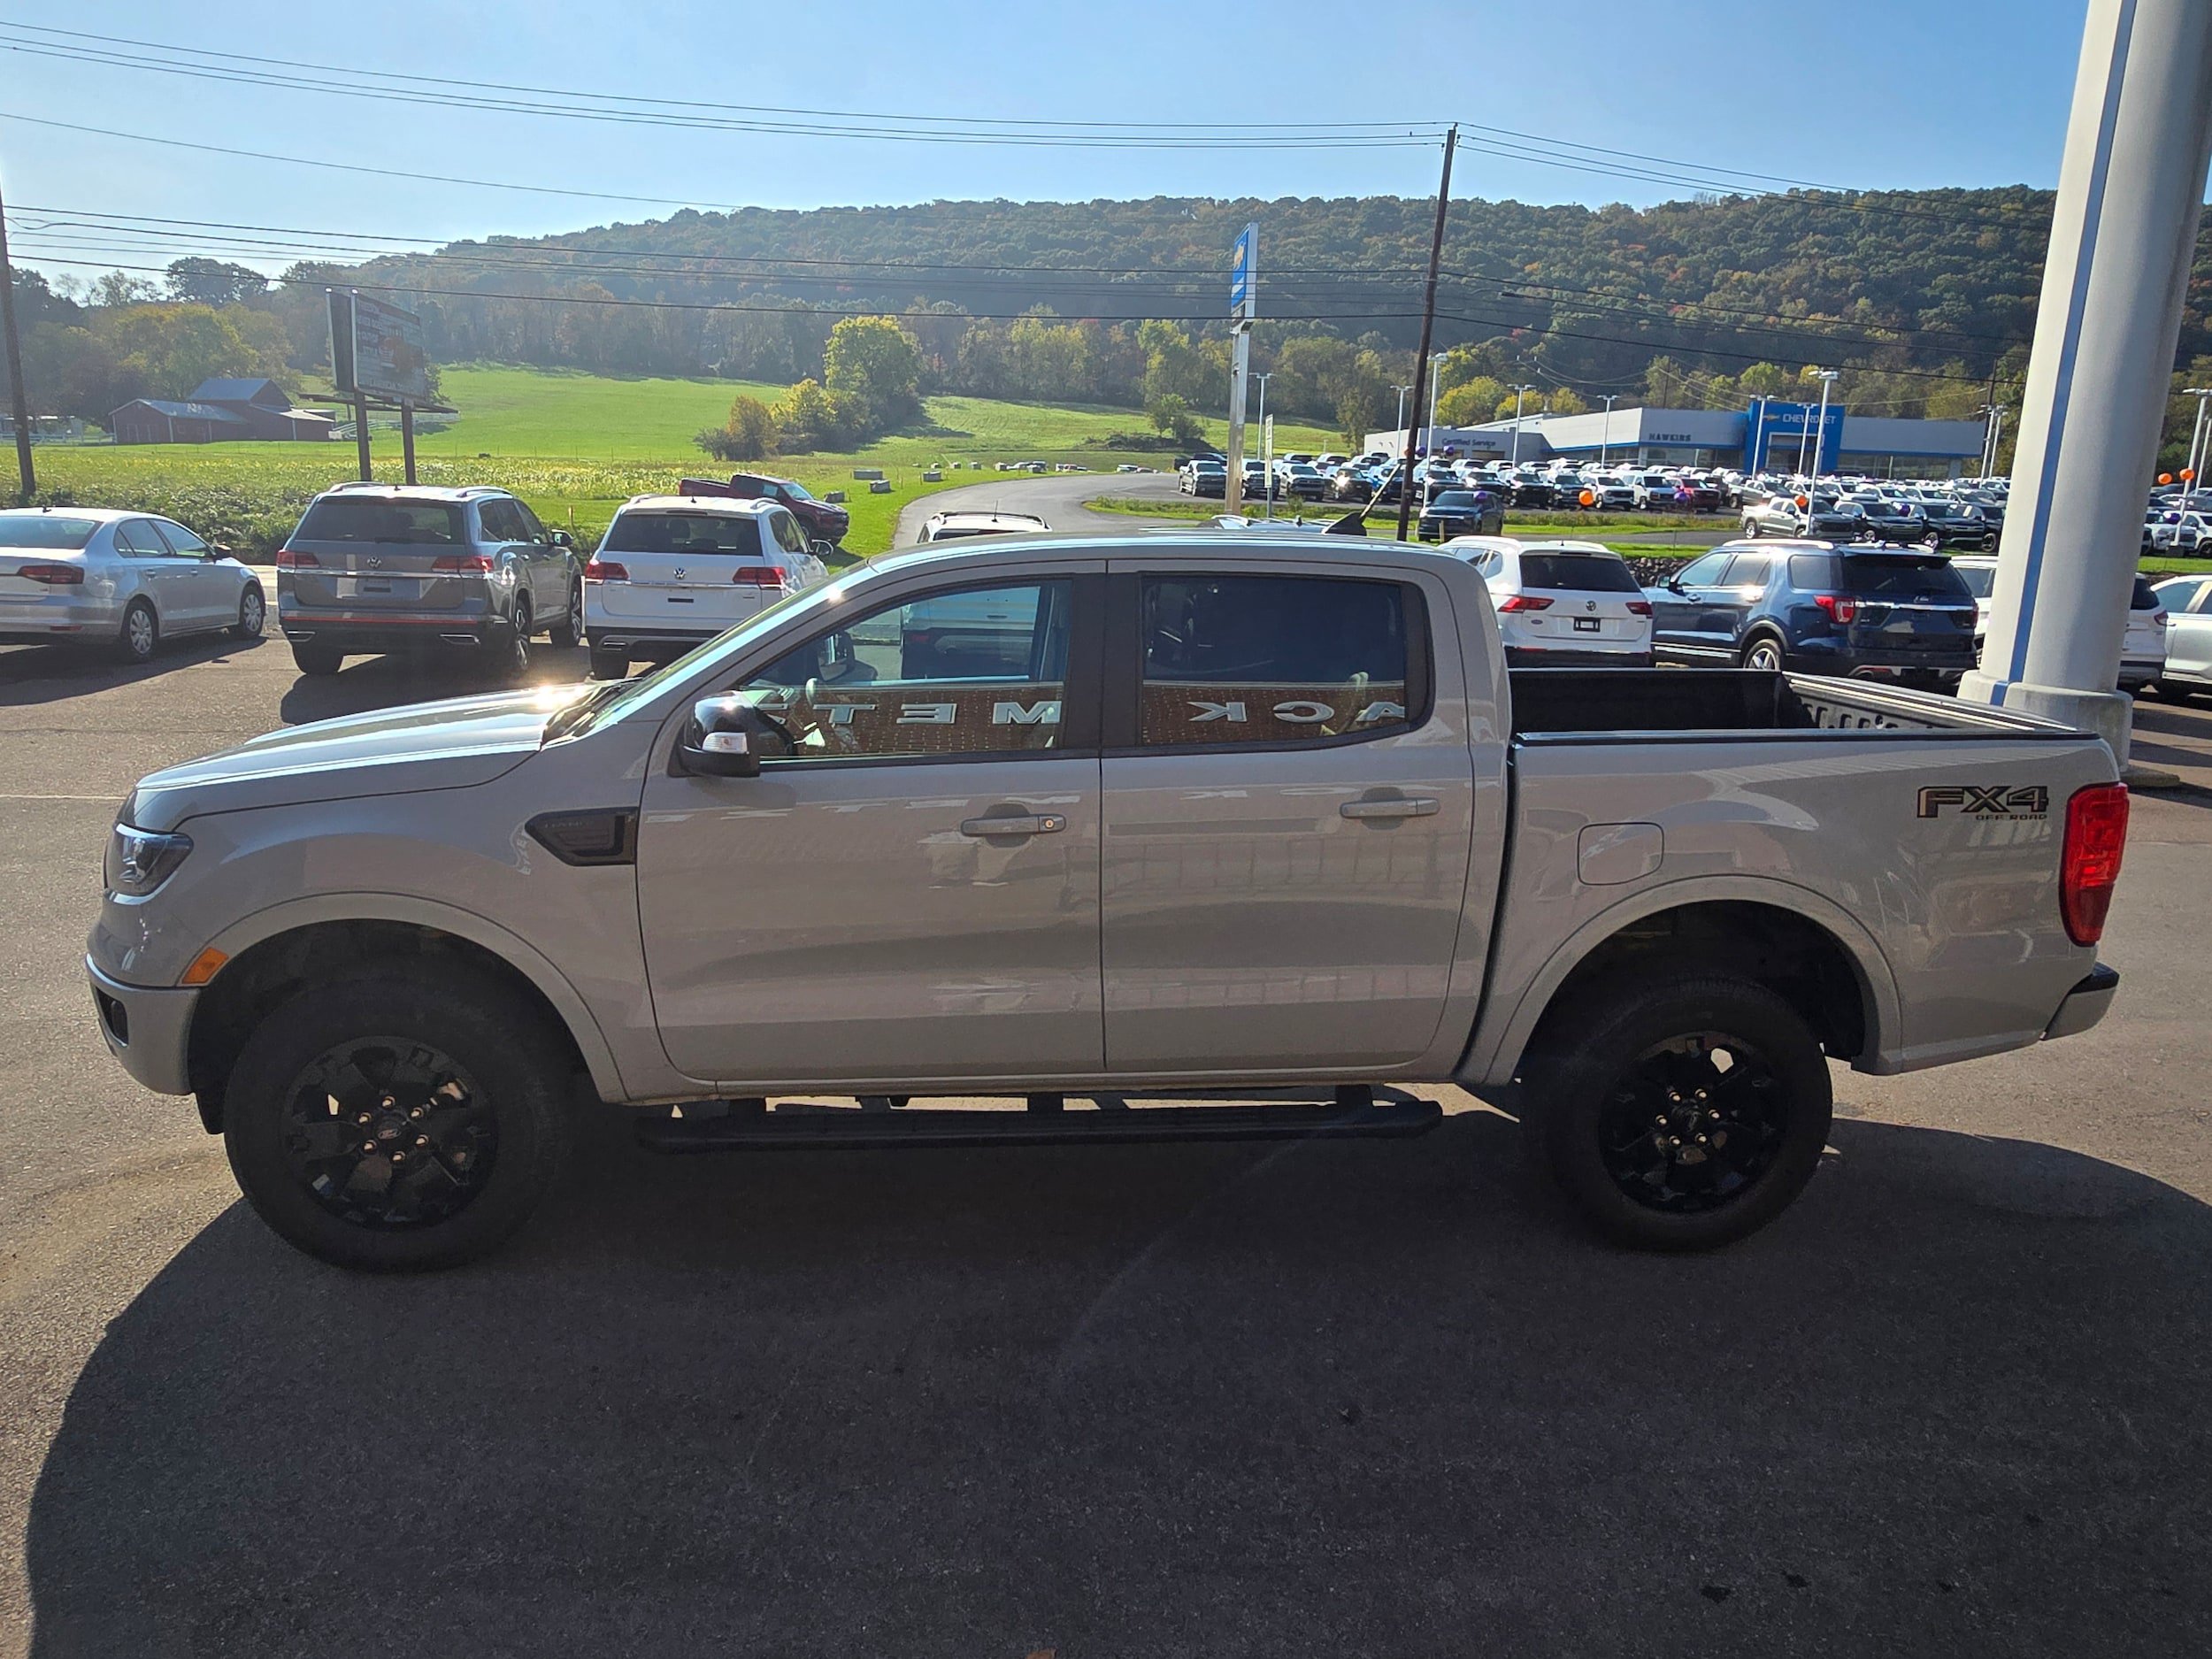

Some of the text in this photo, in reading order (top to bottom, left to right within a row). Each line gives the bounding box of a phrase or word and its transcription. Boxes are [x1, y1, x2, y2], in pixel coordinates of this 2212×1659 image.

[1782, 413, 1837, 425] CHEVROET
[1441, 437, 1471, 446] Certified
[1916, 786, 2049, 818] FX4
